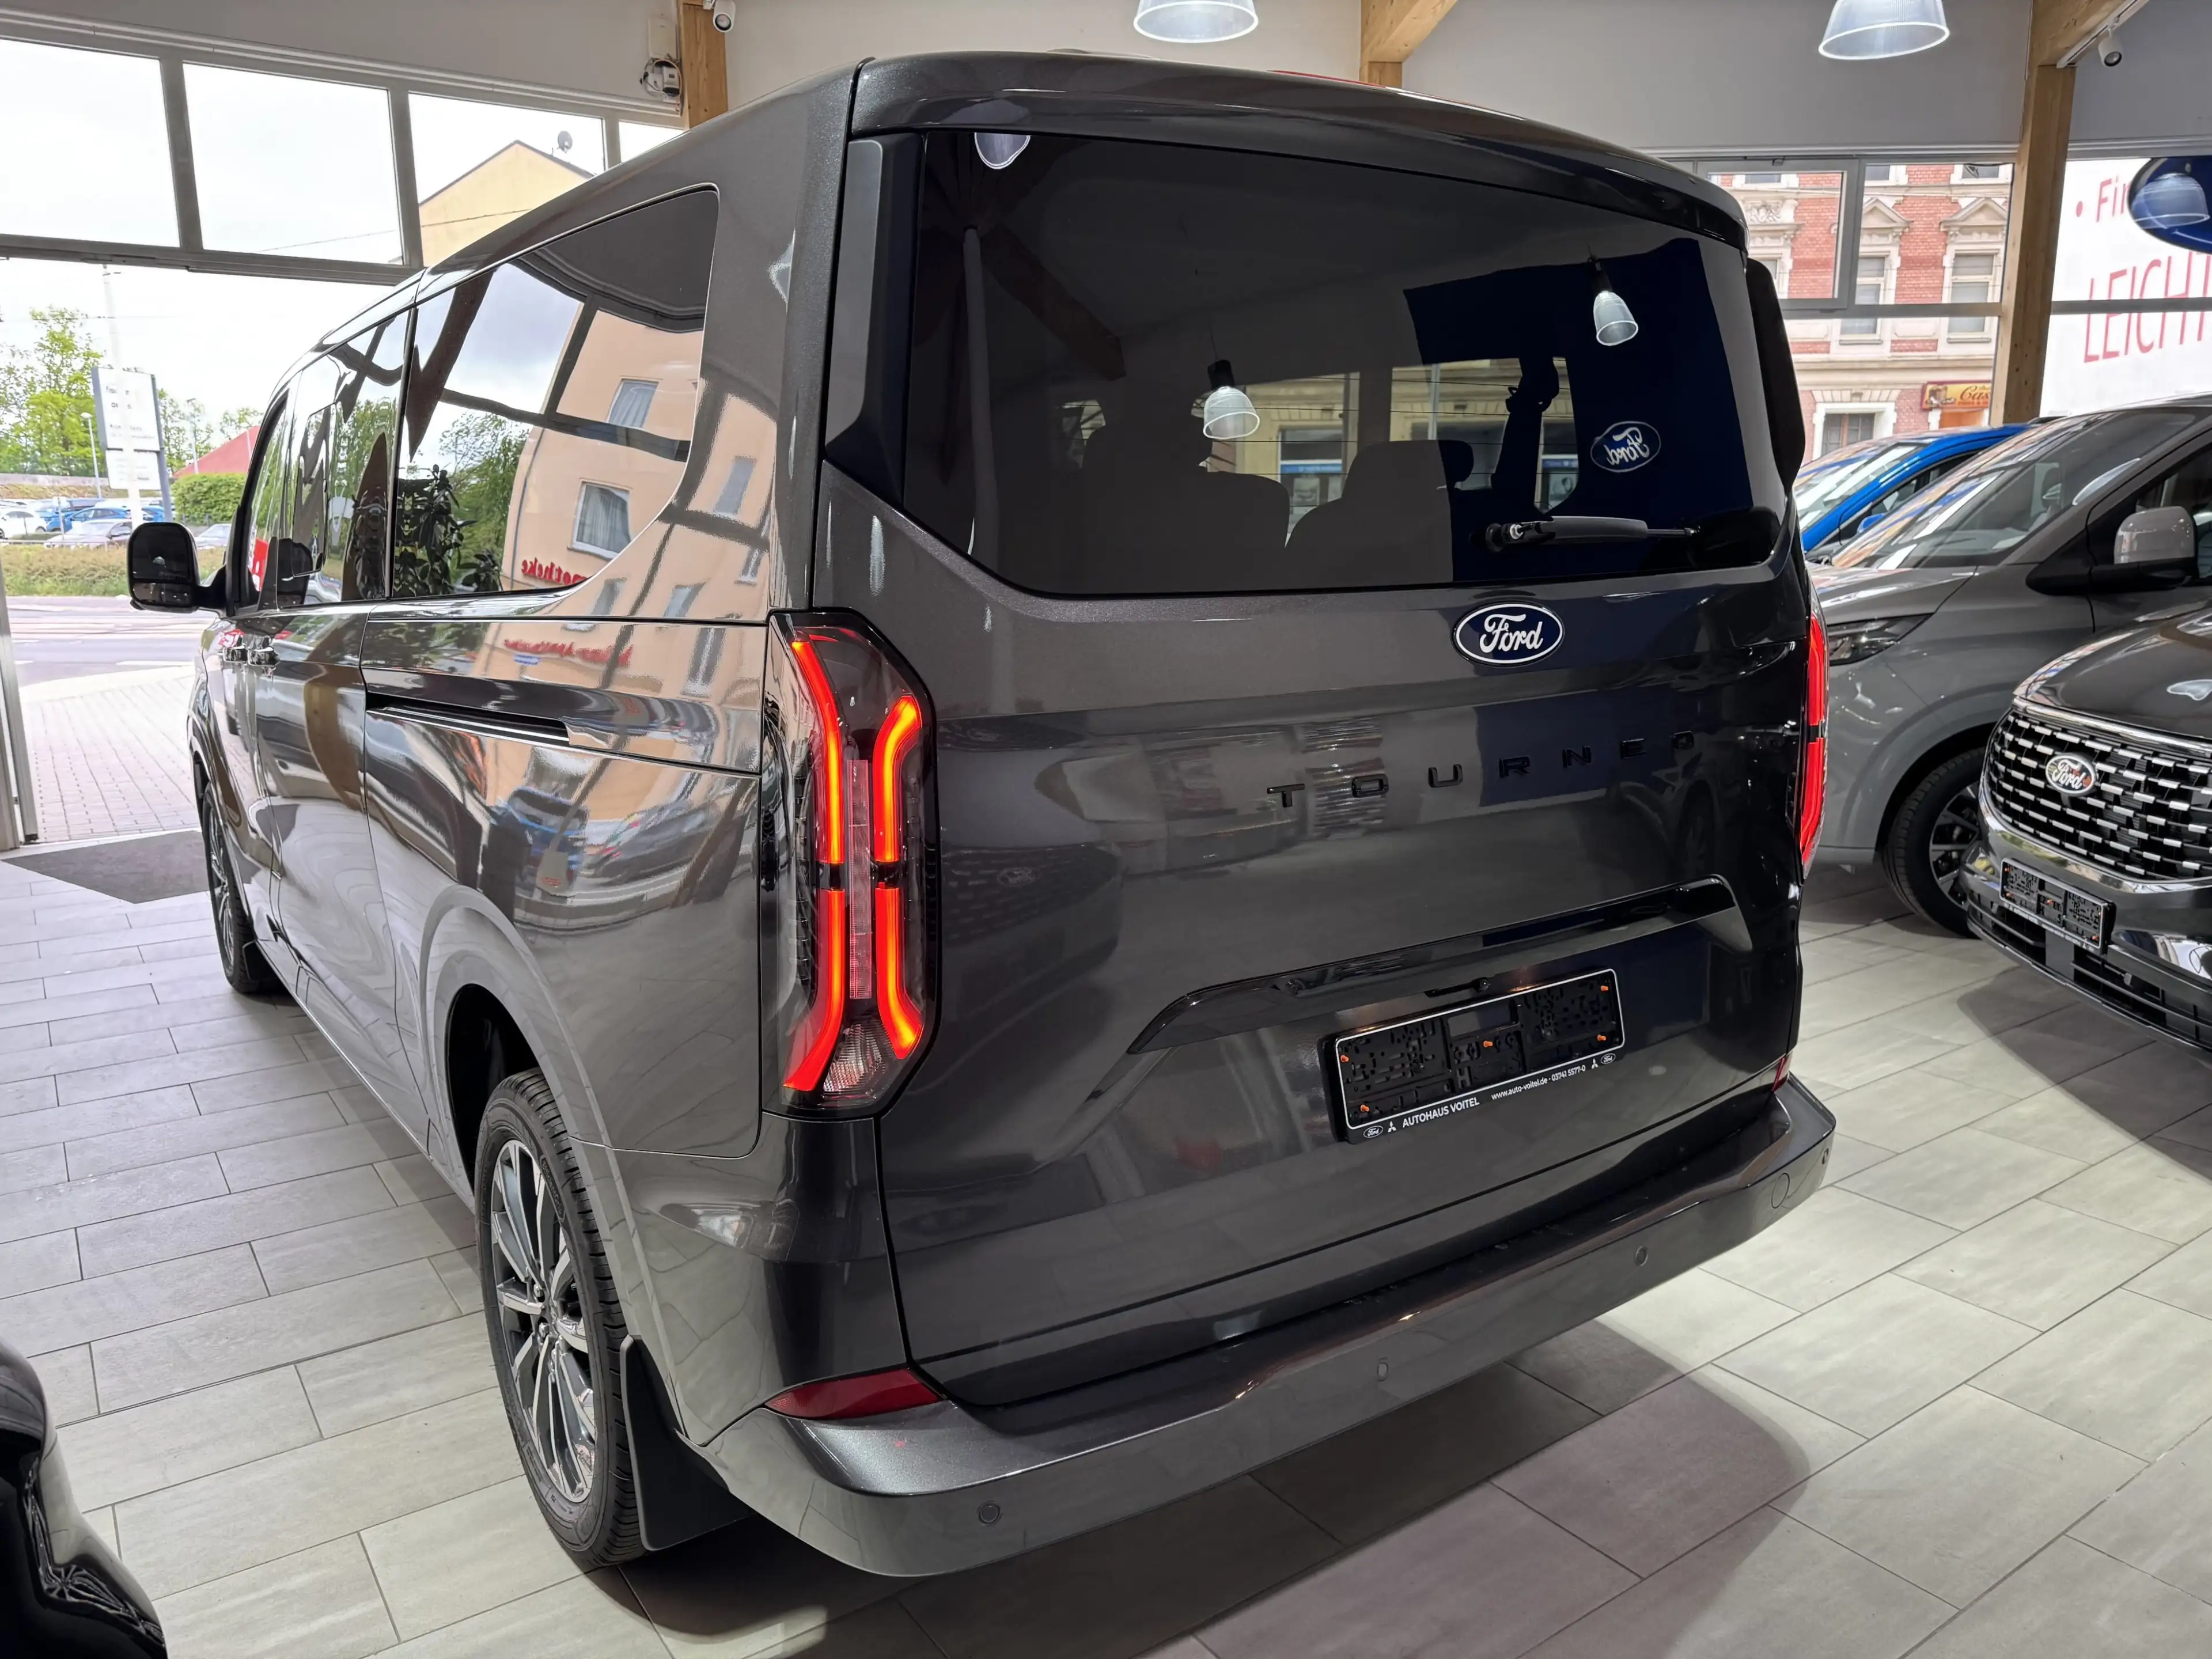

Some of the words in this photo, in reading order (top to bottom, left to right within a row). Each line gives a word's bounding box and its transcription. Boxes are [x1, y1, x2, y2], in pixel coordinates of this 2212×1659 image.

[1479, 613, 1543, 653] Ford
[1267, 730, 1695, 808] TOURNEO
[2052, 759, 2086, 790] Ford
[1491, 1076, 1548, 1100] www.auto-voitel.de
[1551, 1071, 1567, 1082] 03741
[1567, 1064, 1586, 1077] 5577-0
[1402, 1105, 1450, 1128] AUTOHAUS
[1450, 1096, 1480, 1113] VOITEL
